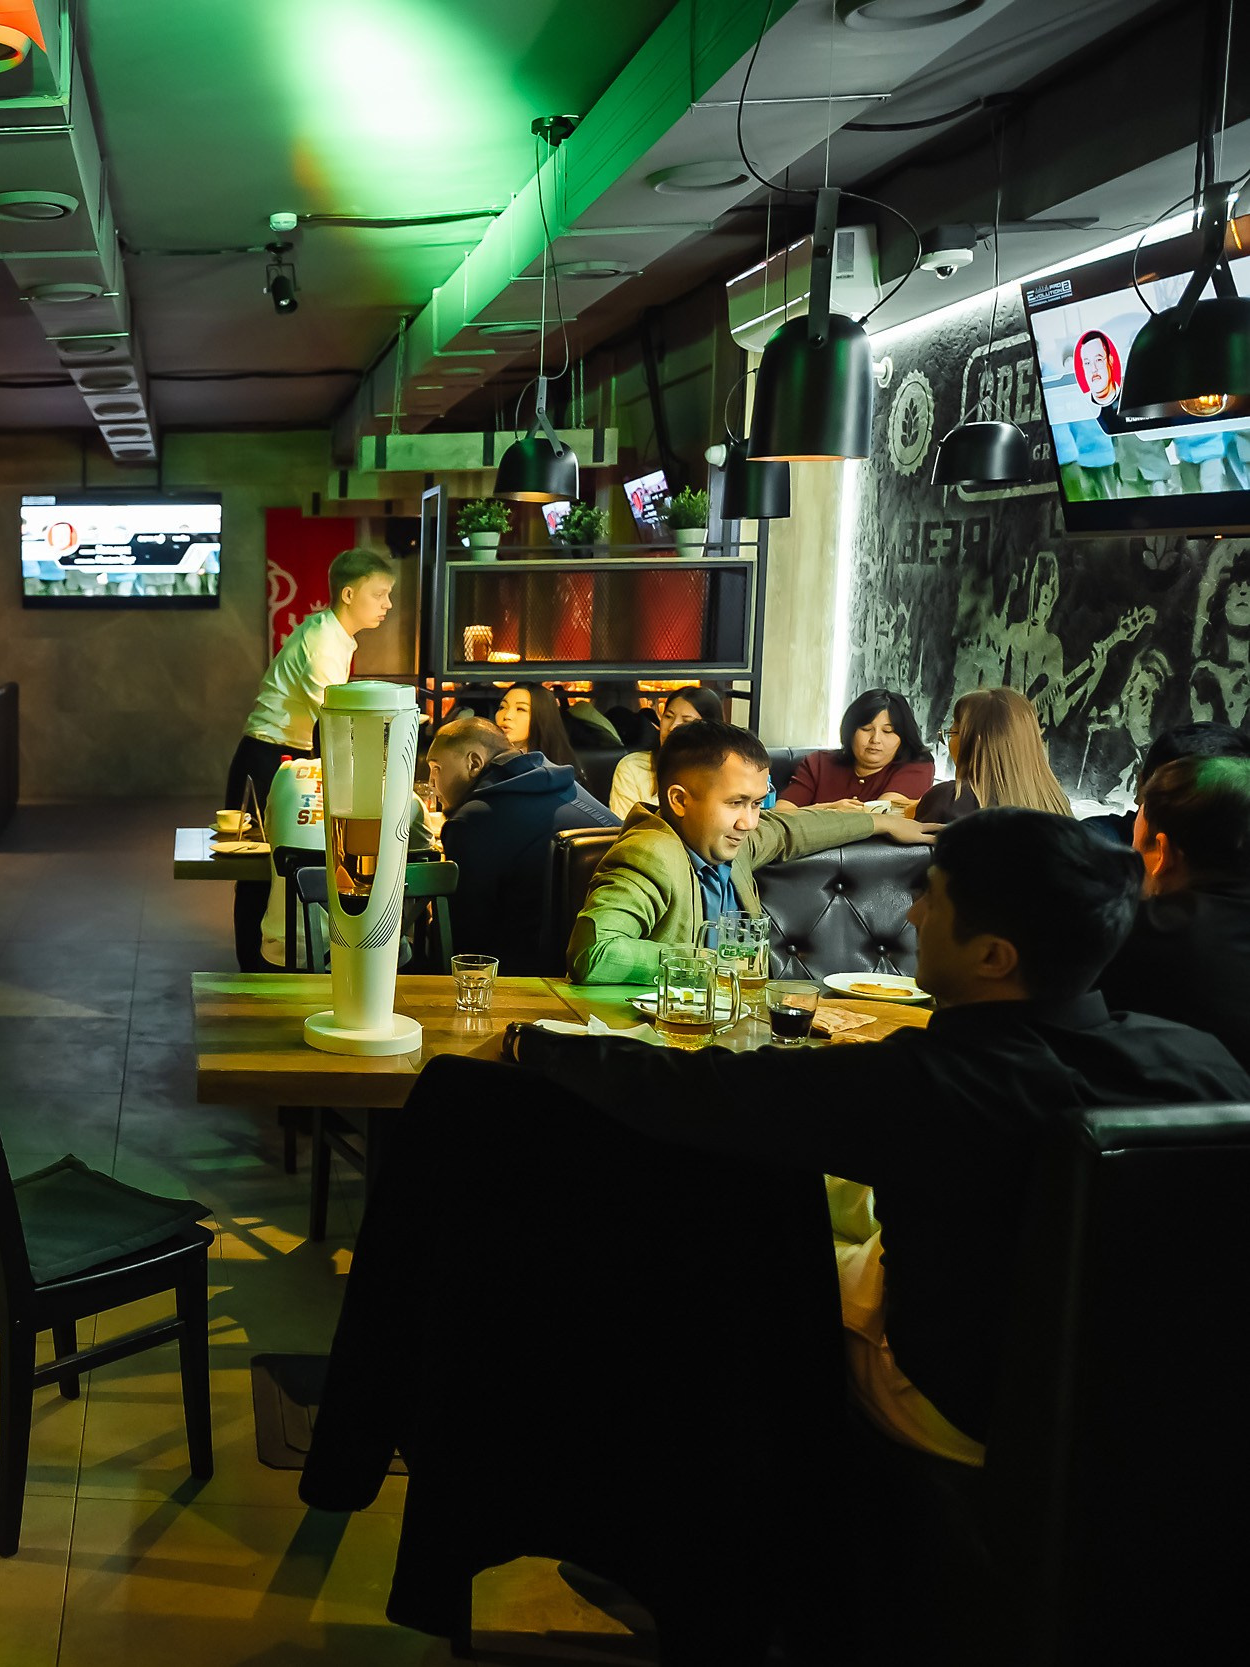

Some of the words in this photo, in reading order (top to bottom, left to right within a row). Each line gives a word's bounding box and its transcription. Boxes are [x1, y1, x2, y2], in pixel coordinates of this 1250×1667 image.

[976, 357, 1042, 425] BRE
[1032, 443, 1051, 460] GR
[296, 766, 323, 779] CH
[297, 809, 324, 825] SP
